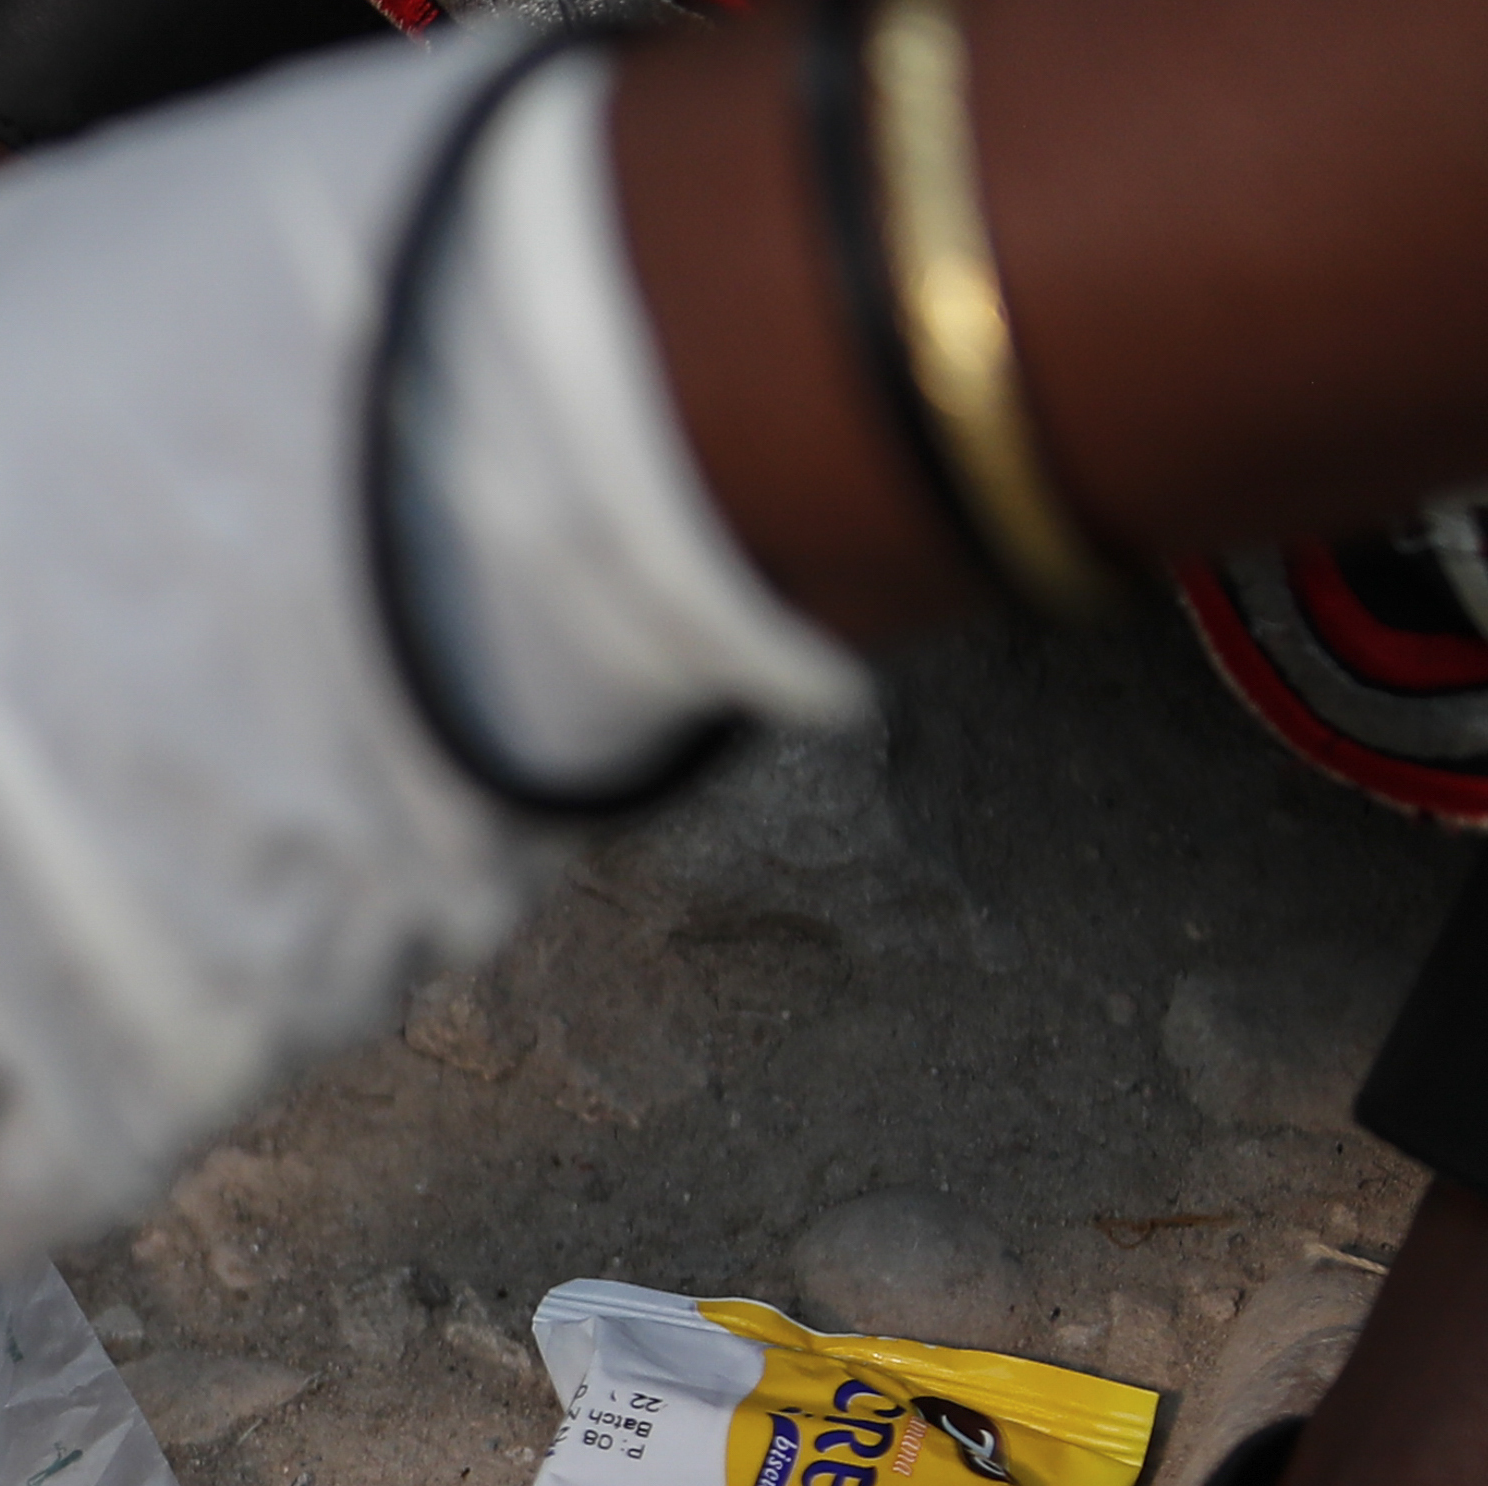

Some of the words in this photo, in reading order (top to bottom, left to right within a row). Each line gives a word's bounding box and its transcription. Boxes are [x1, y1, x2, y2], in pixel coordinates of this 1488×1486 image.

[628, 1391, 663, 1414] 22
[587, 1408, 653, 1438] Batch
[581, 1428, 614, 1451] 08
[890, 1417, 930, 1476] anana
